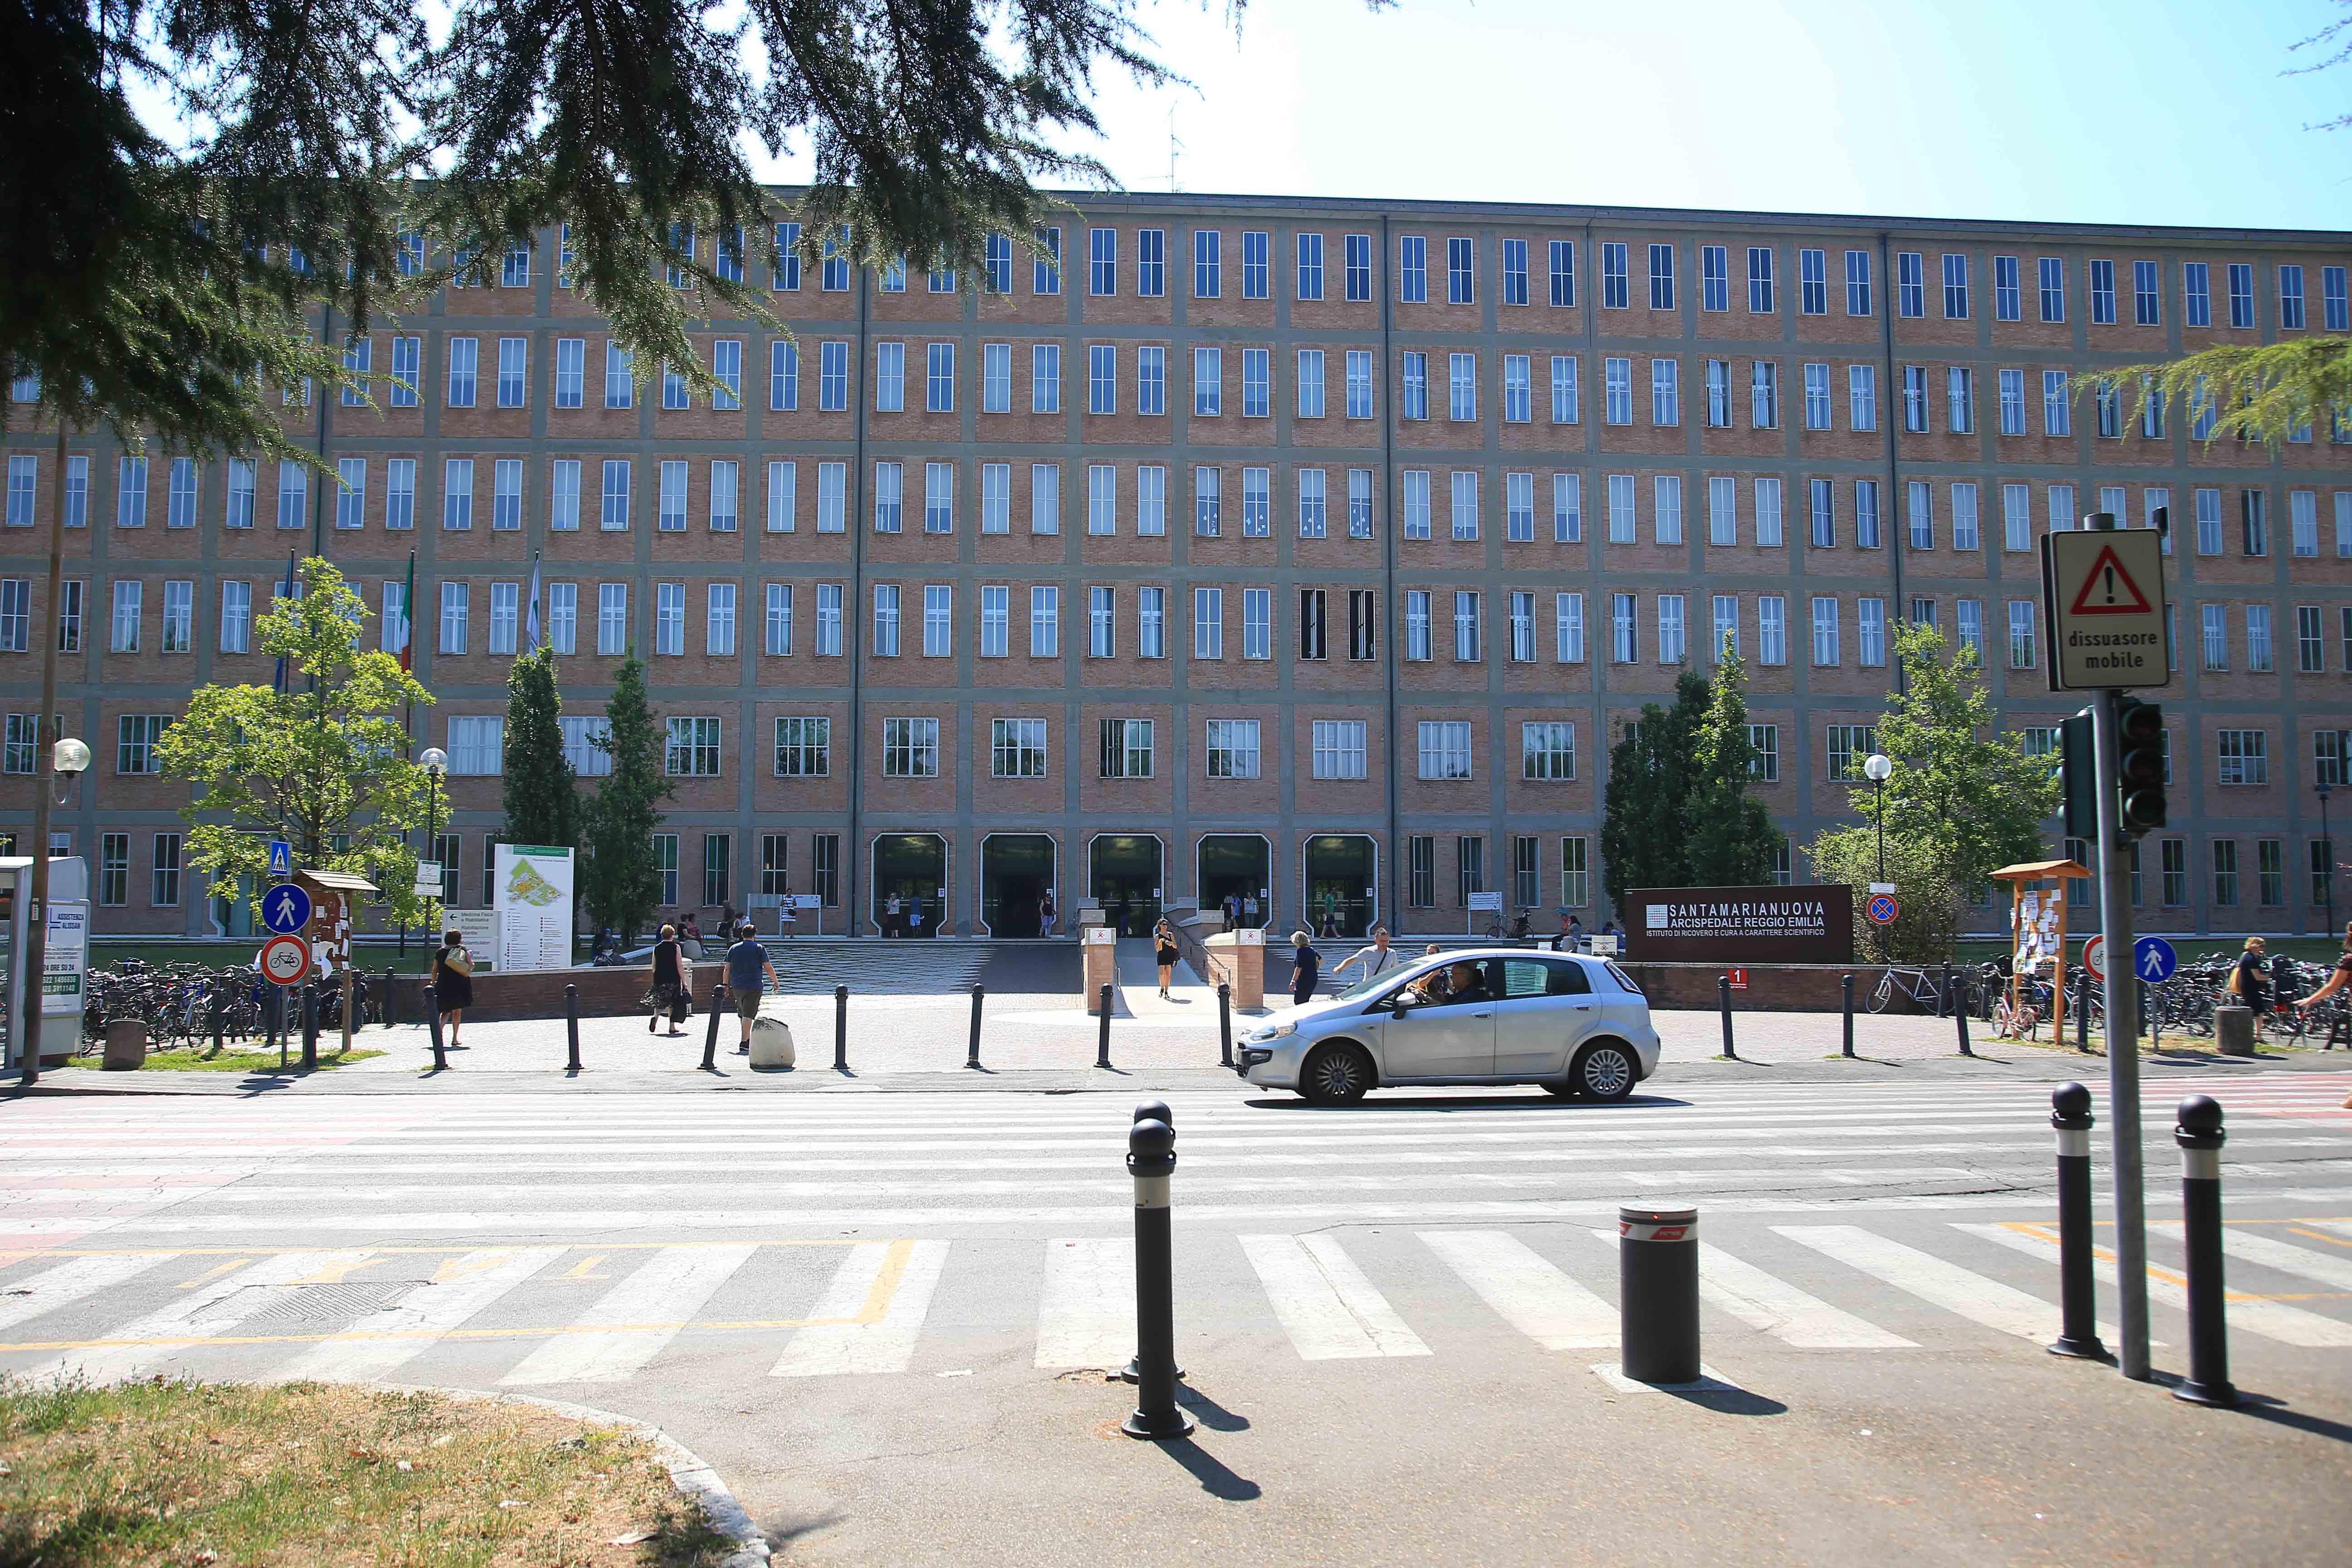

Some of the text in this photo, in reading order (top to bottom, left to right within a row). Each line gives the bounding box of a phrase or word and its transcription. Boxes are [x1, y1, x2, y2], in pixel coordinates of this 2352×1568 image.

[2069, 630, 2157, 646] dissuasore
[2086, 652, 2144, 668] mobile
[1670, 902, 1824, 916] SANTAMARIANUOVA
[1671, 917, 1824, 928] ARCISPEDALE REGGIO EMILIA
[1735, 970, 1740, 982] 1
